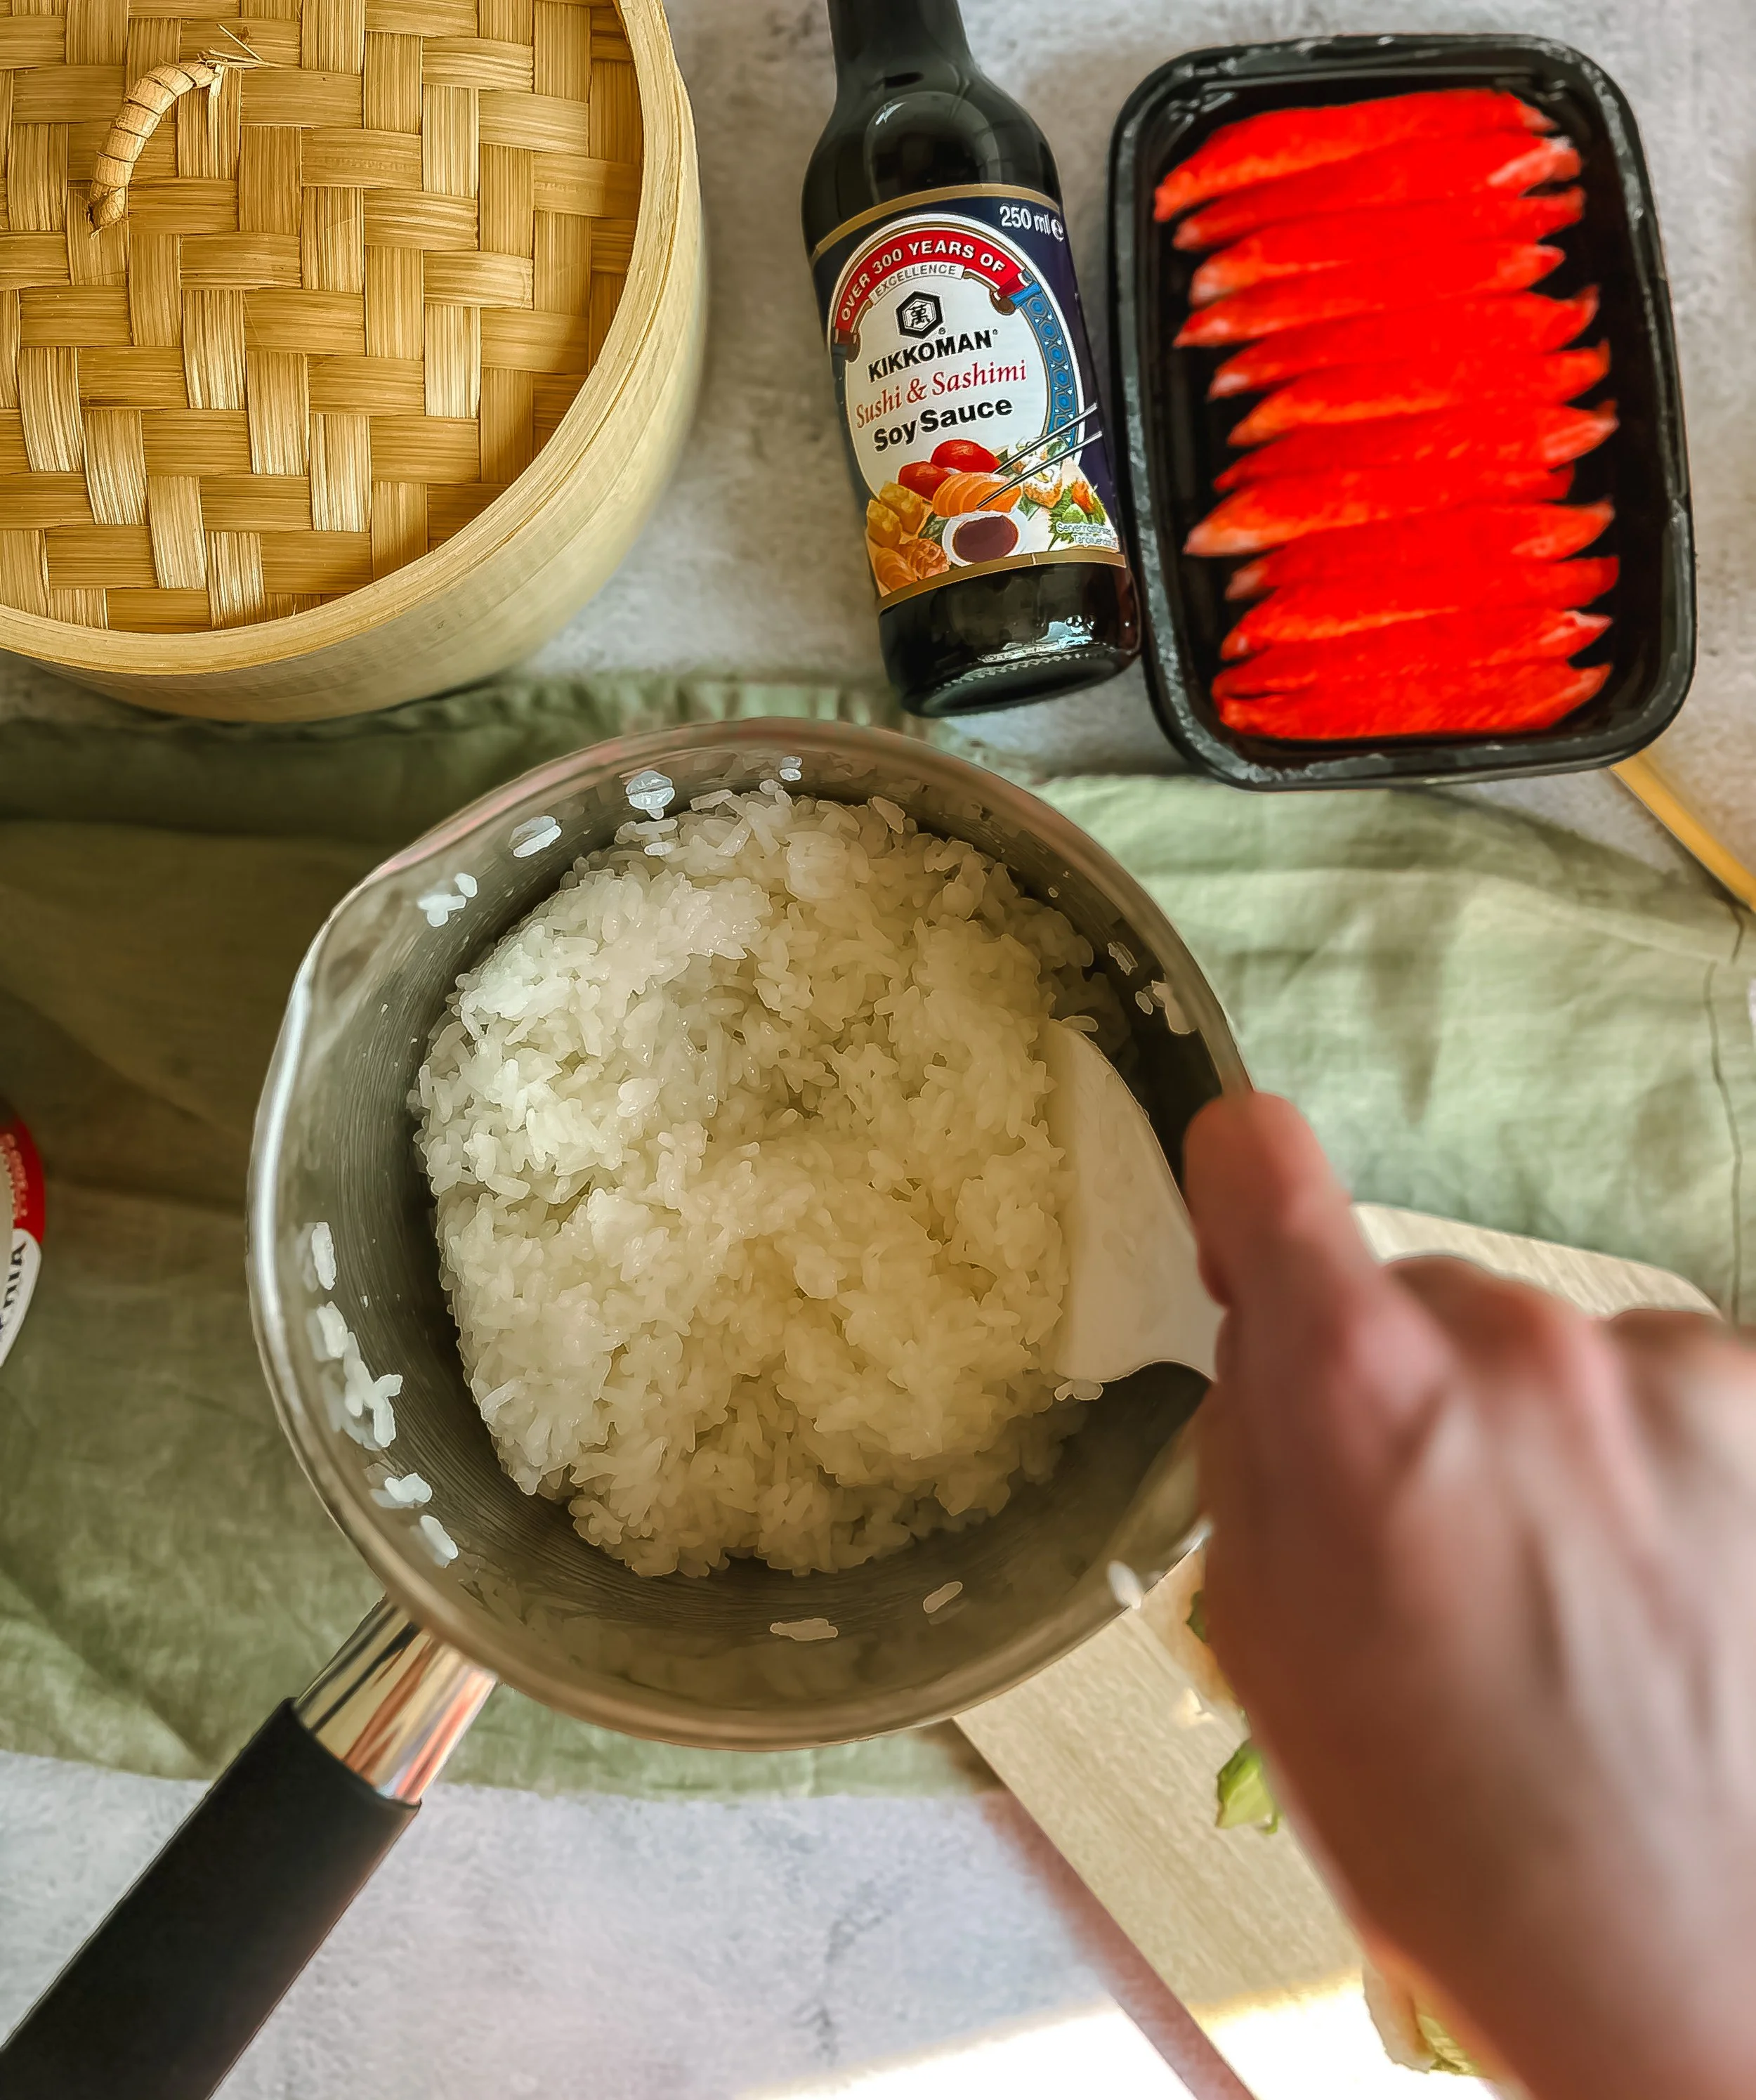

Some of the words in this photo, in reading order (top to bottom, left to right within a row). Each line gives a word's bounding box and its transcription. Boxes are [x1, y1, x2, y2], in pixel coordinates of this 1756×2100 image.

[1000, 206, 1032, 230] 250
[1033, 214, 1051, 236] ml
[841, 273, 870, 320] OVER
[872, 249, 903, 274] 300
[908, 240, 975, 259] YEARS
[980, 253, 1005, 272] OF
[874, 264, 957, 296] EXCELLENCE
[868, 330, 992, 382] KIKKOMAN
[856, 386, 902, 428] Sushi
[906, 378, 927, 403] &
[932, 360, 1026, 395] Sashimi
[874, 420, 917, 452] Soy
[920, 399, 1012, 433] Sauce
